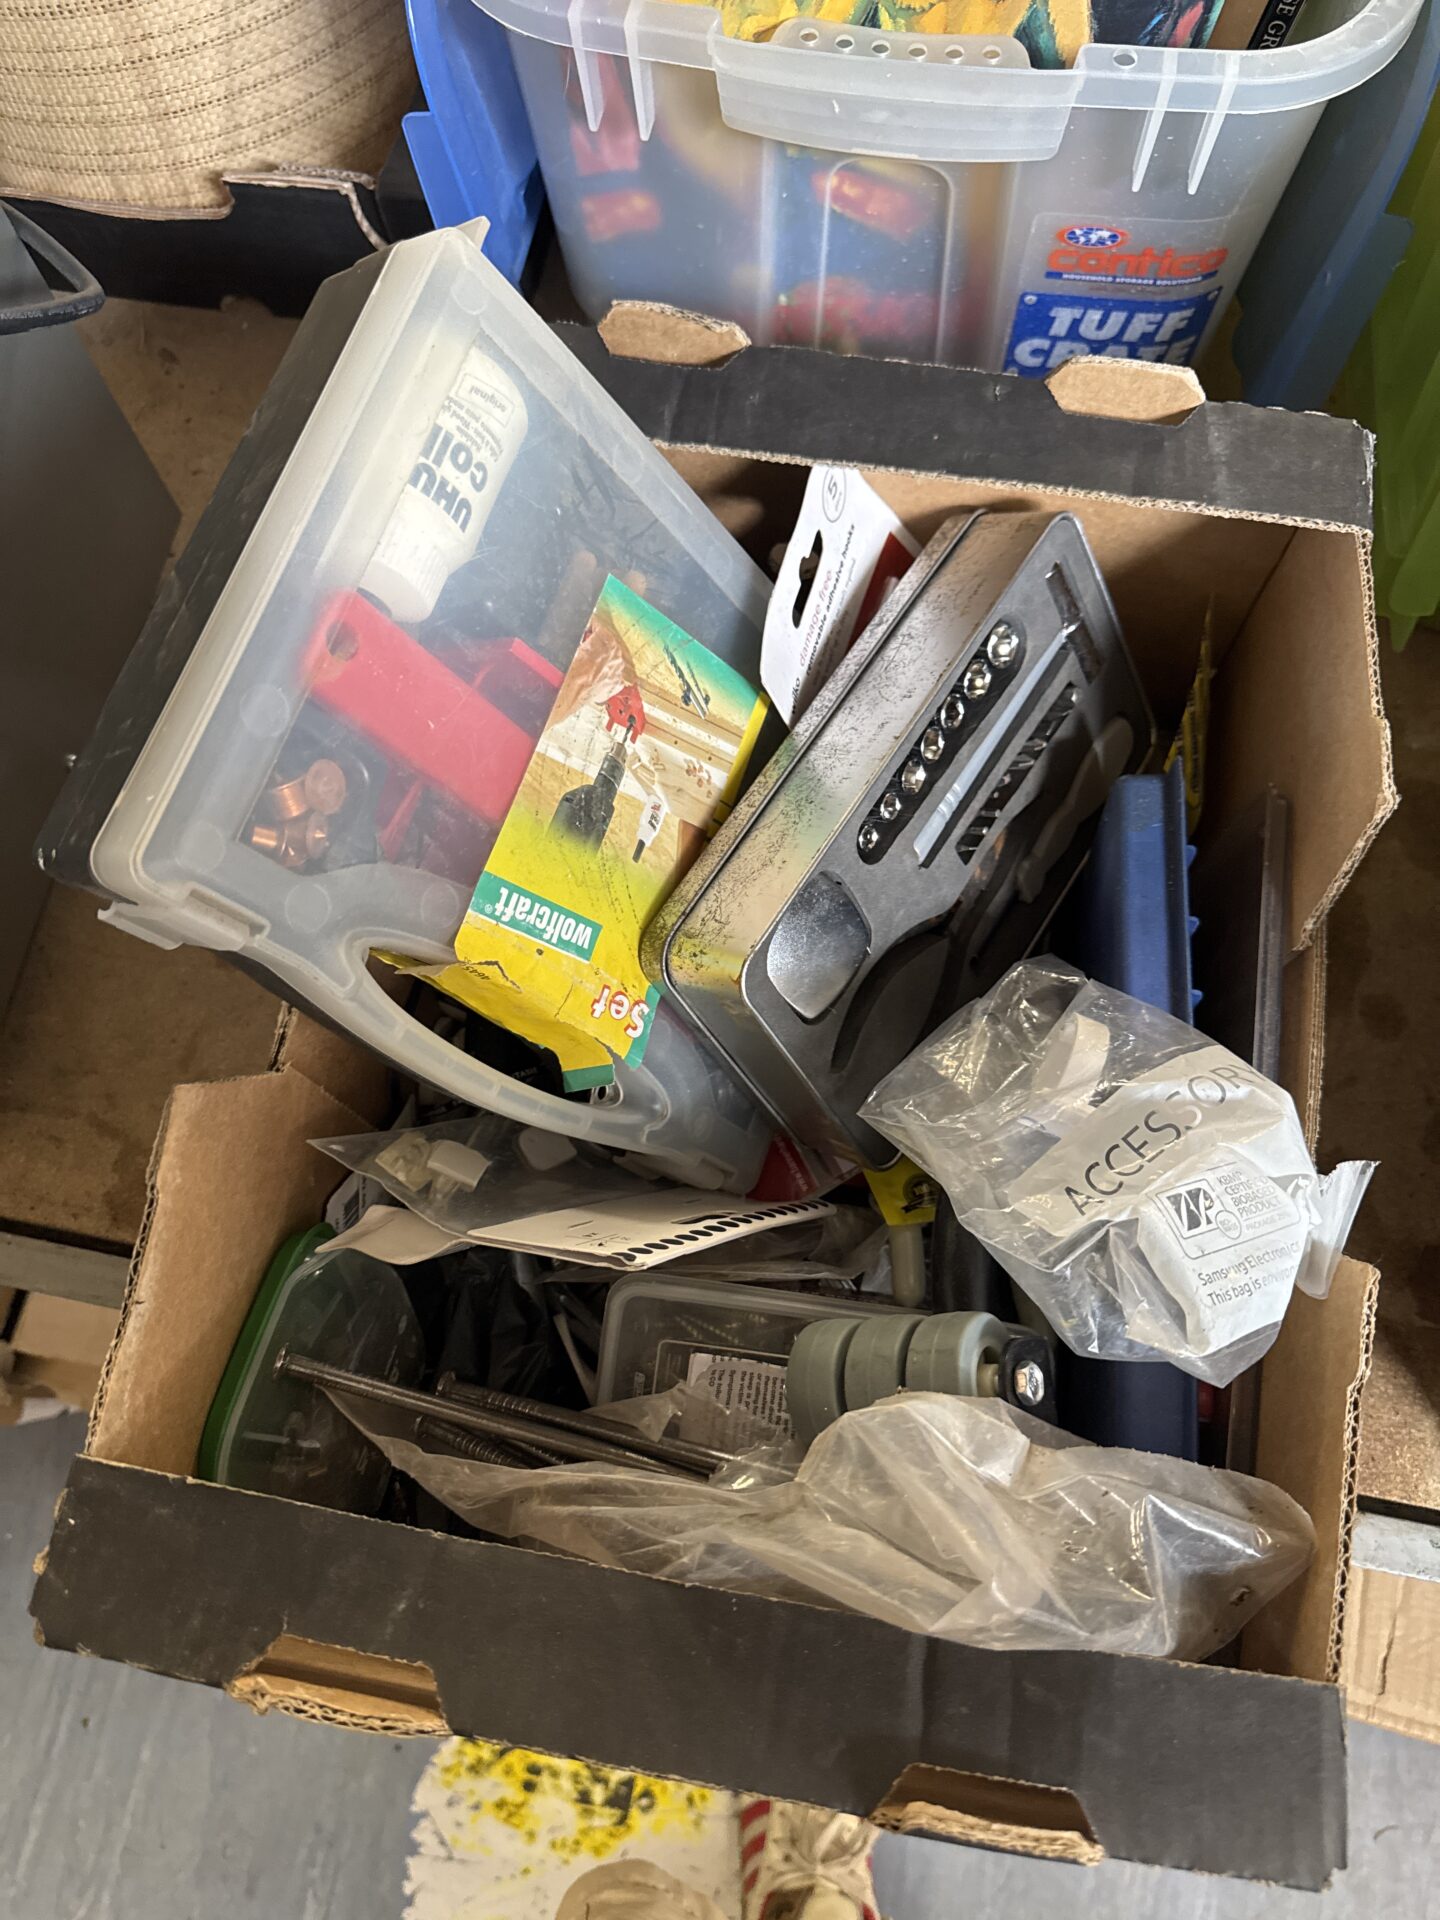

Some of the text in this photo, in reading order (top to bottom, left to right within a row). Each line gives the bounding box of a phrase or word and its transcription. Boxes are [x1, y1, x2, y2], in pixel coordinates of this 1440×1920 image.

[1259, 20, 1287, 48] GR
[1047, 246, 1228, 277] contico
[1062, 273, 1202, 286] HOUSEHOLD STORAGE SOLUTIONS
[1048, 307, 1196, 343] TUFF
[468, 385, 506, 413] original
[405, 463, 471, 533] UHU
[826, 473, 838, 501] 5
[805, 524, 856, 676] removable adhesive hooks
[799, 603, 822, 668] damage
[817, 568, 834, 601] free
[790, 676, 803, 714] wilko
[591, 984, 649, 1038] Set
[1064, 1060, 1267, 1216] ACCESSORY
[1230, 1184, 1277, 1207] BIOBASED
[1237, 1195, 1282, 1218] PRODUCT
[1197, 1262, 1248, 1286] Samsung
[1206, 1287, 1232, 1306] This
[1231, 1284, 1253, 1298] bag
[1249, 1277, 1262, 1290] is
[707, 1375, 715, 1387] CO
[717, 1368, 725, 1381] The
[724, 1368, 736, 1406] Symptoms
[746, 1371, 754, 1390] sleep
[756, 1372, 762, 1381] or
[736, 1382, 745, 1404] victim
[752, 1381, 762, 1405] calling
[759, 1375, 770, 1414] themselves
[768, 1376, 778, 1405] become
